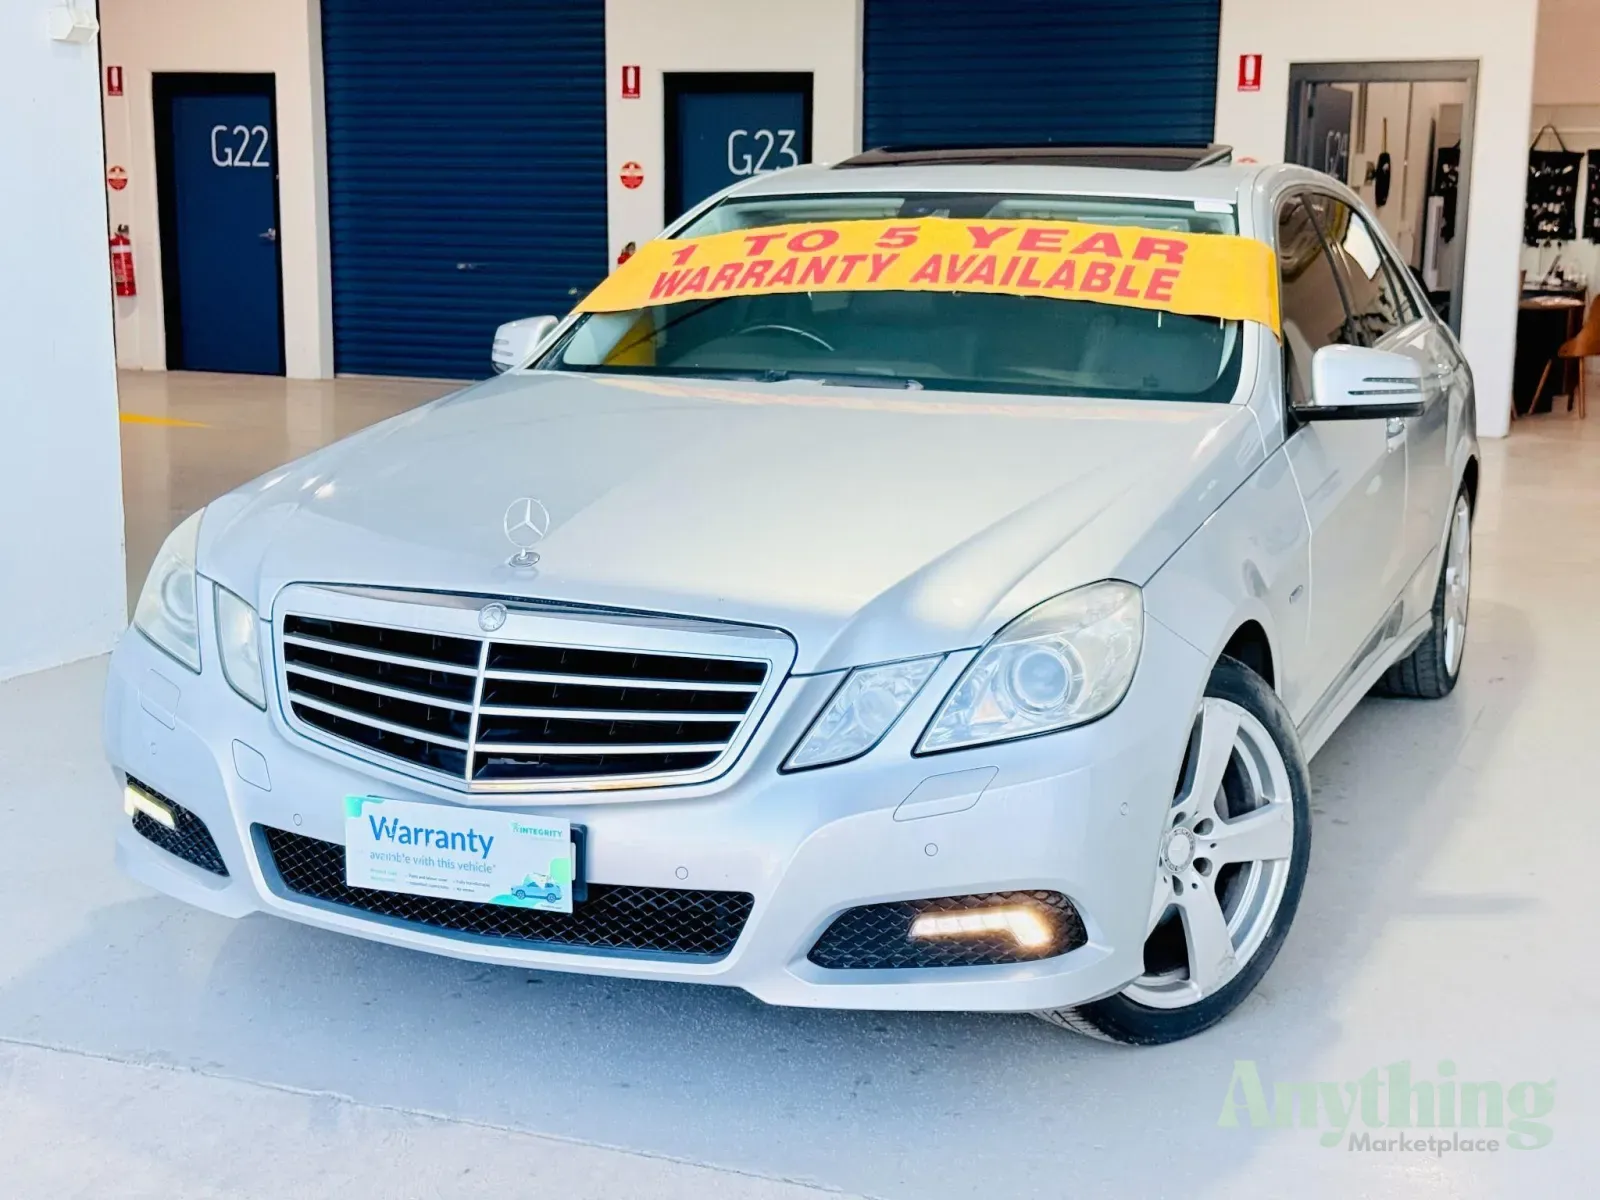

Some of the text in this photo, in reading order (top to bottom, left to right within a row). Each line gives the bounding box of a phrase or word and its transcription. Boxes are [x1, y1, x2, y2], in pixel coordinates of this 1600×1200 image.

[211, 125, 270, 167] G22
[727, 129, 799, 176] G23
[671, 226, 1189, 266] 1 TO 5 YEAR
[649, 253, 1181, 302] WARRANTY AVAILABLE
[368, 814, 495, 860] Warranty
[520, 827, 563, 838] INTEGRITY
[413, 855, 435, 867] with
[437, 857, 455, 869] this
